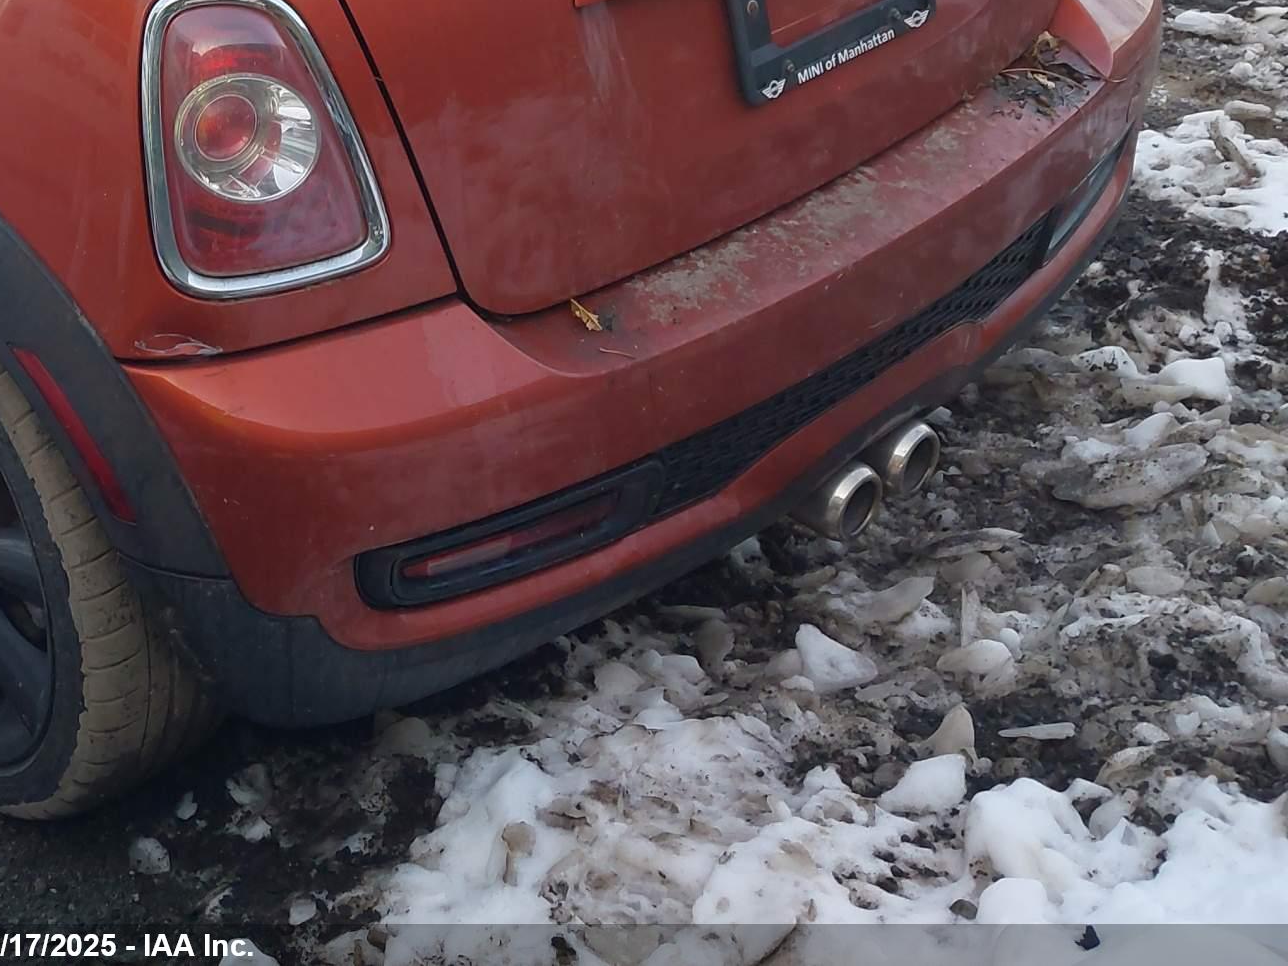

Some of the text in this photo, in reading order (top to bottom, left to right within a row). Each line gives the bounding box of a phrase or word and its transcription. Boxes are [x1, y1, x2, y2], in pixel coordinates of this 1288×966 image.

[797, 29, 896, 85] MINI of Manhattan
